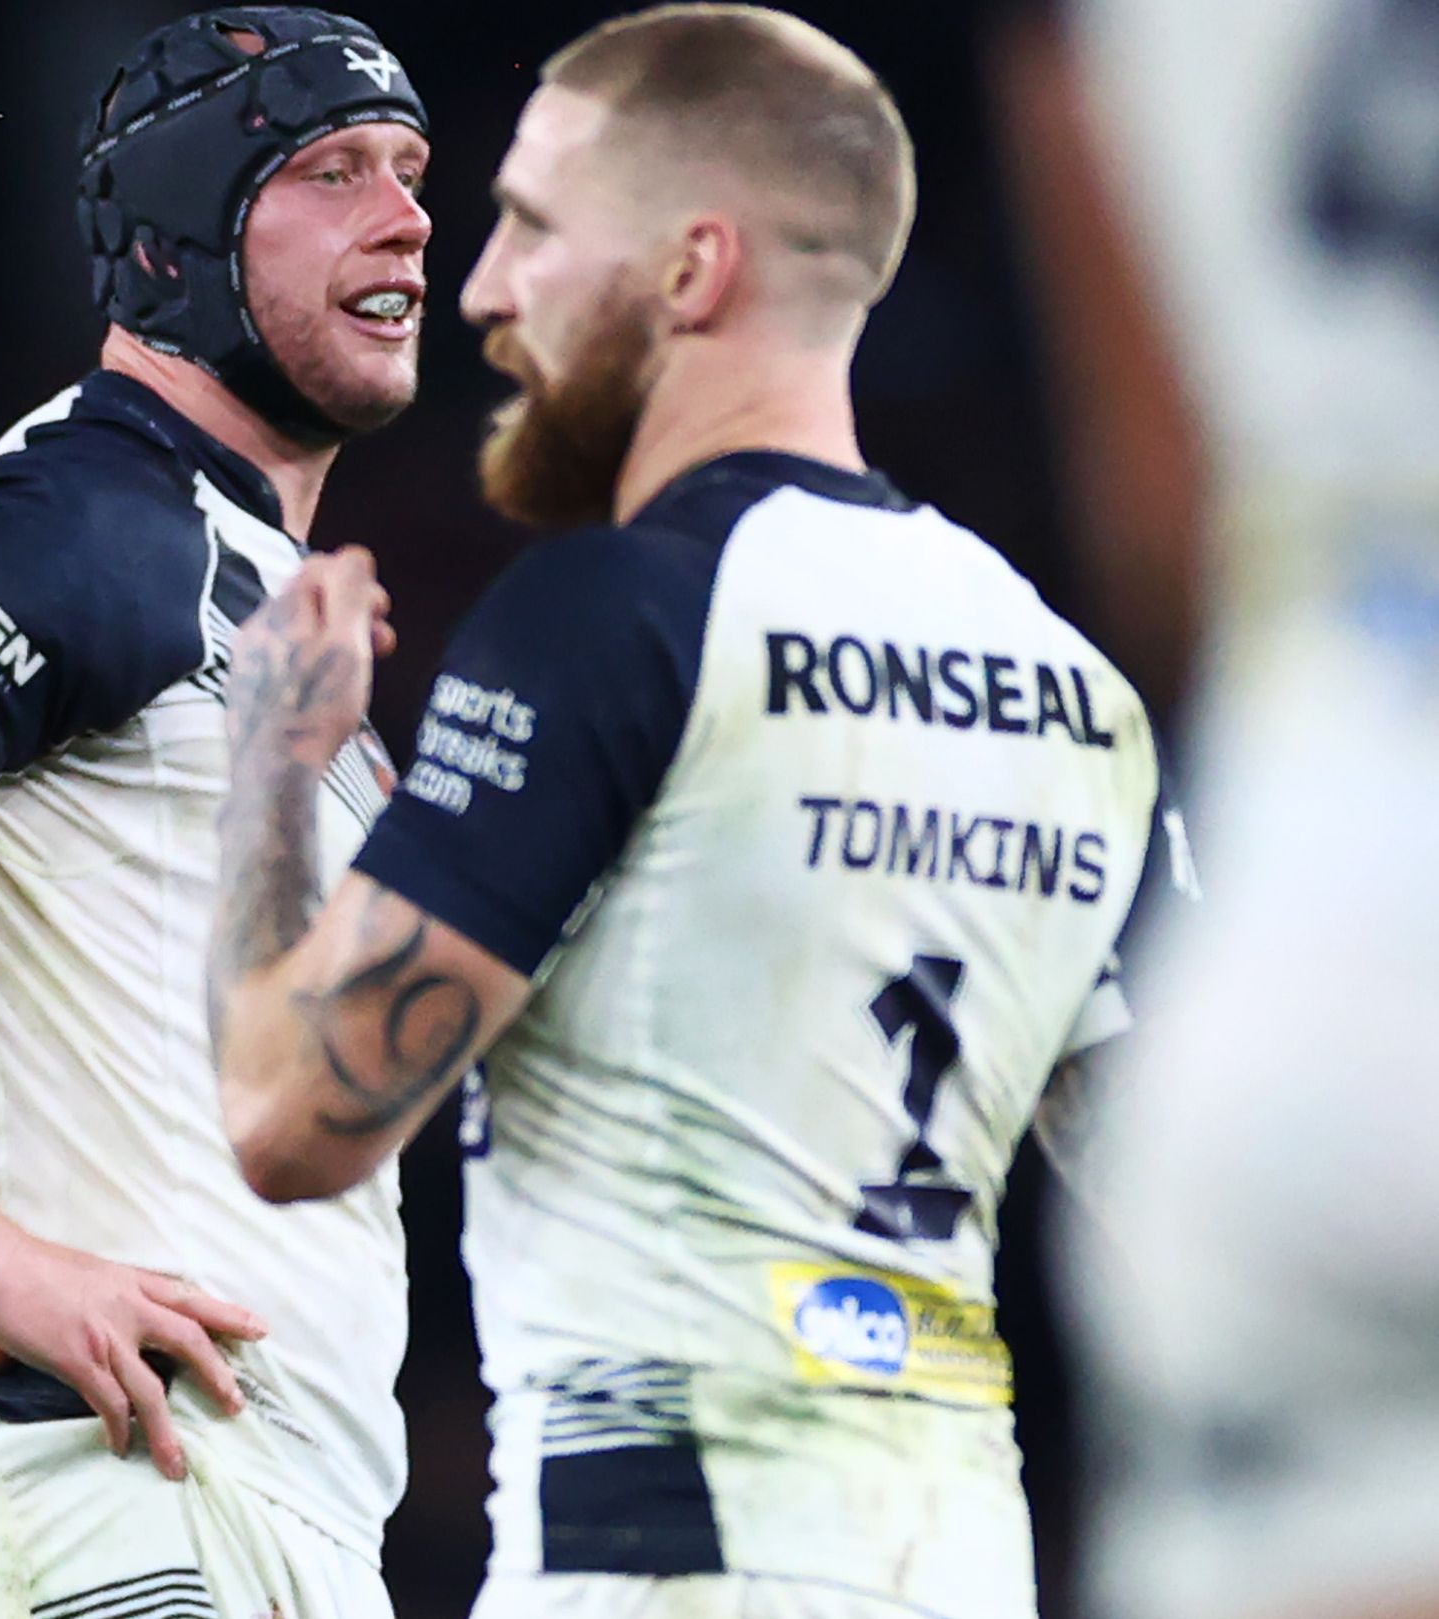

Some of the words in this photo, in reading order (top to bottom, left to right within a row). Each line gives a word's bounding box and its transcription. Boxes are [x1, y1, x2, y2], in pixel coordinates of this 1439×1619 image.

[765, 632, 1114, 749] RONSEAL
[800, 796, 1107, 903] TOMKINS
[853, 954, 971, 1240] 1
